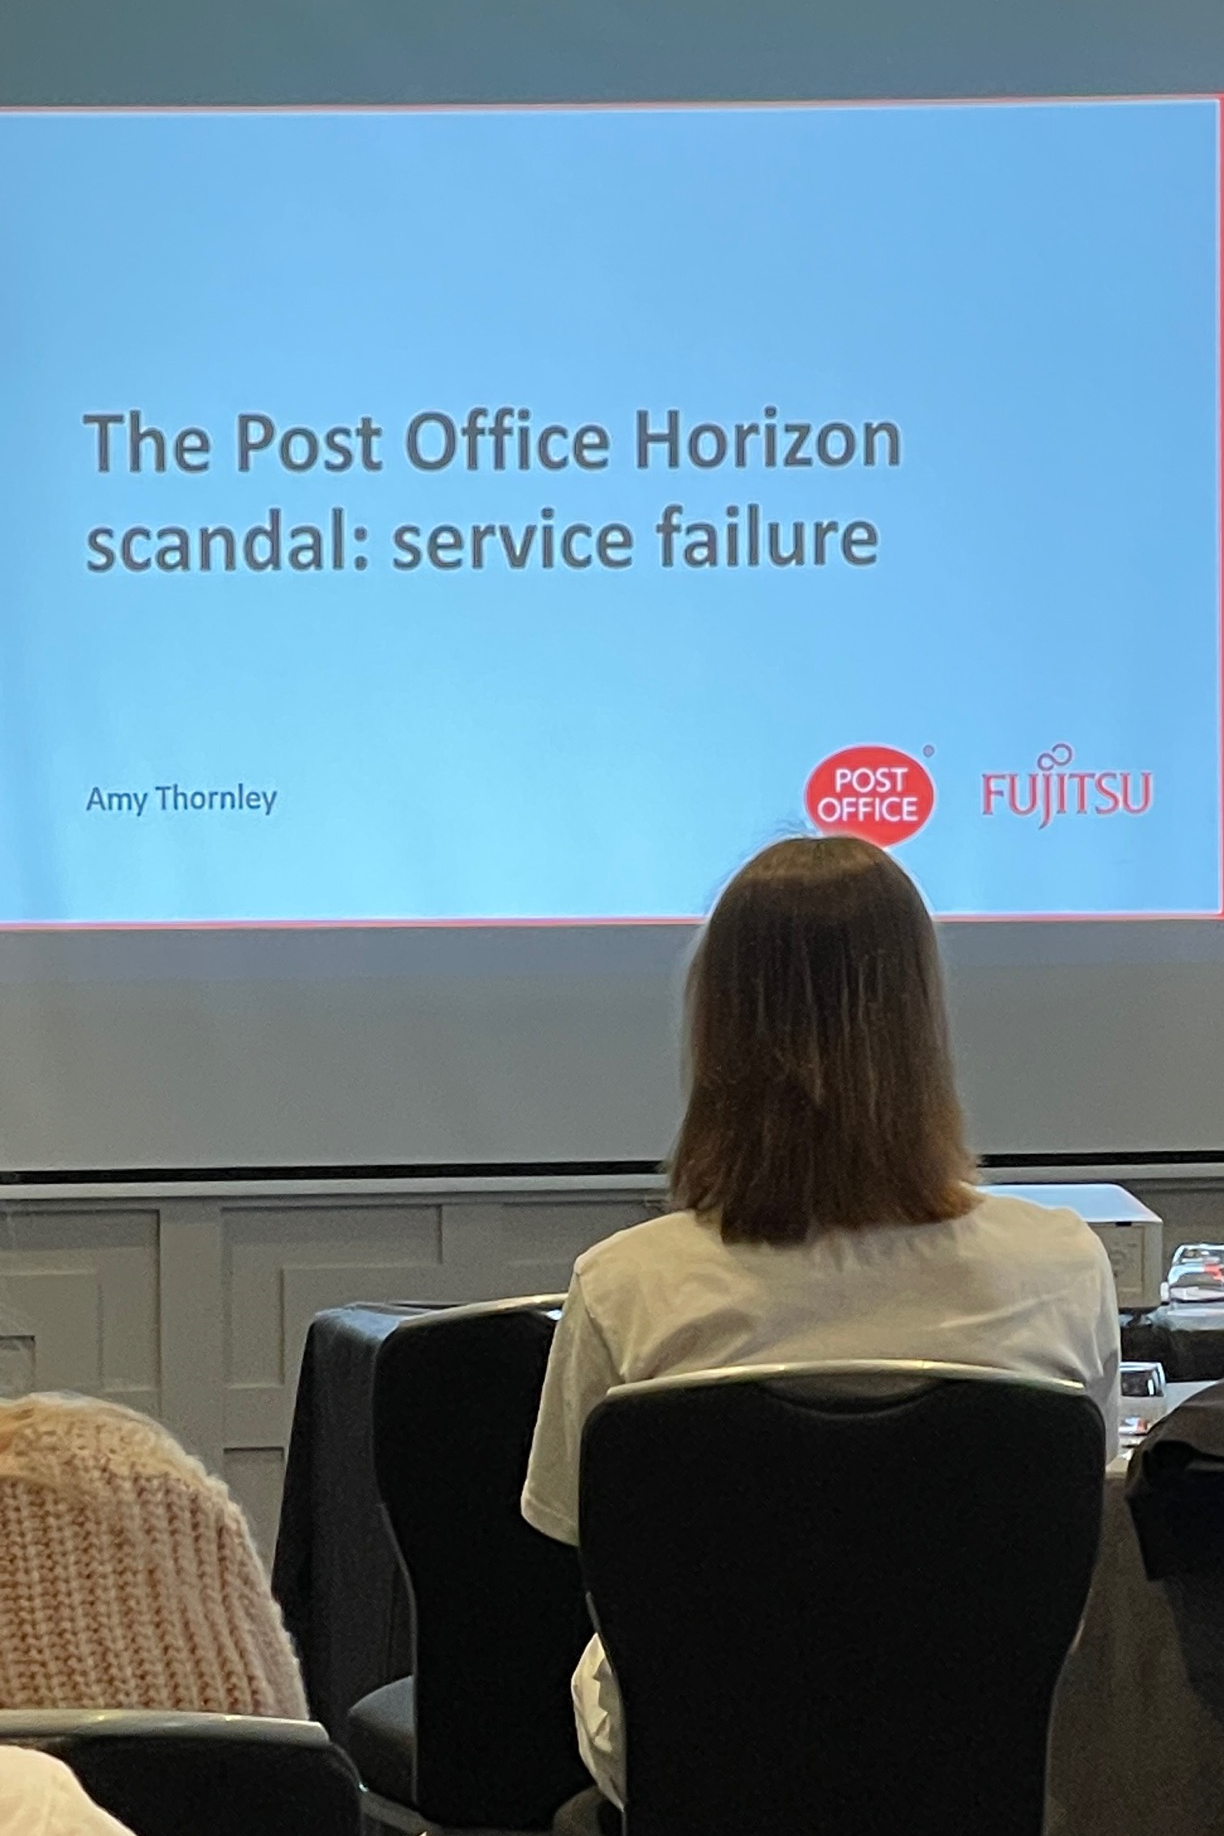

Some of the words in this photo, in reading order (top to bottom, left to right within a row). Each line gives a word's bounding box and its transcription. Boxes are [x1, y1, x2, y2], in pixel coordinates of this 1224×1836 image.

[84, 411, 210, 473] The
[237, 411, 383, 473] Post
[404, 408, 611, 471] Office
[635, 405, 902, 469] Horizon
[86, 507, 368, 574] scandal:
[392, 507, 634, 571] service
[656, 503, 880, 569] failure
[86, 786, 148, 817] Amy
[155, 783, 278, 816] Thornley
[835, 767, 908, 794] POST
[981, 770, 1153, 830] FUJITSU
[817, 797, 918, 823] OFFICE
